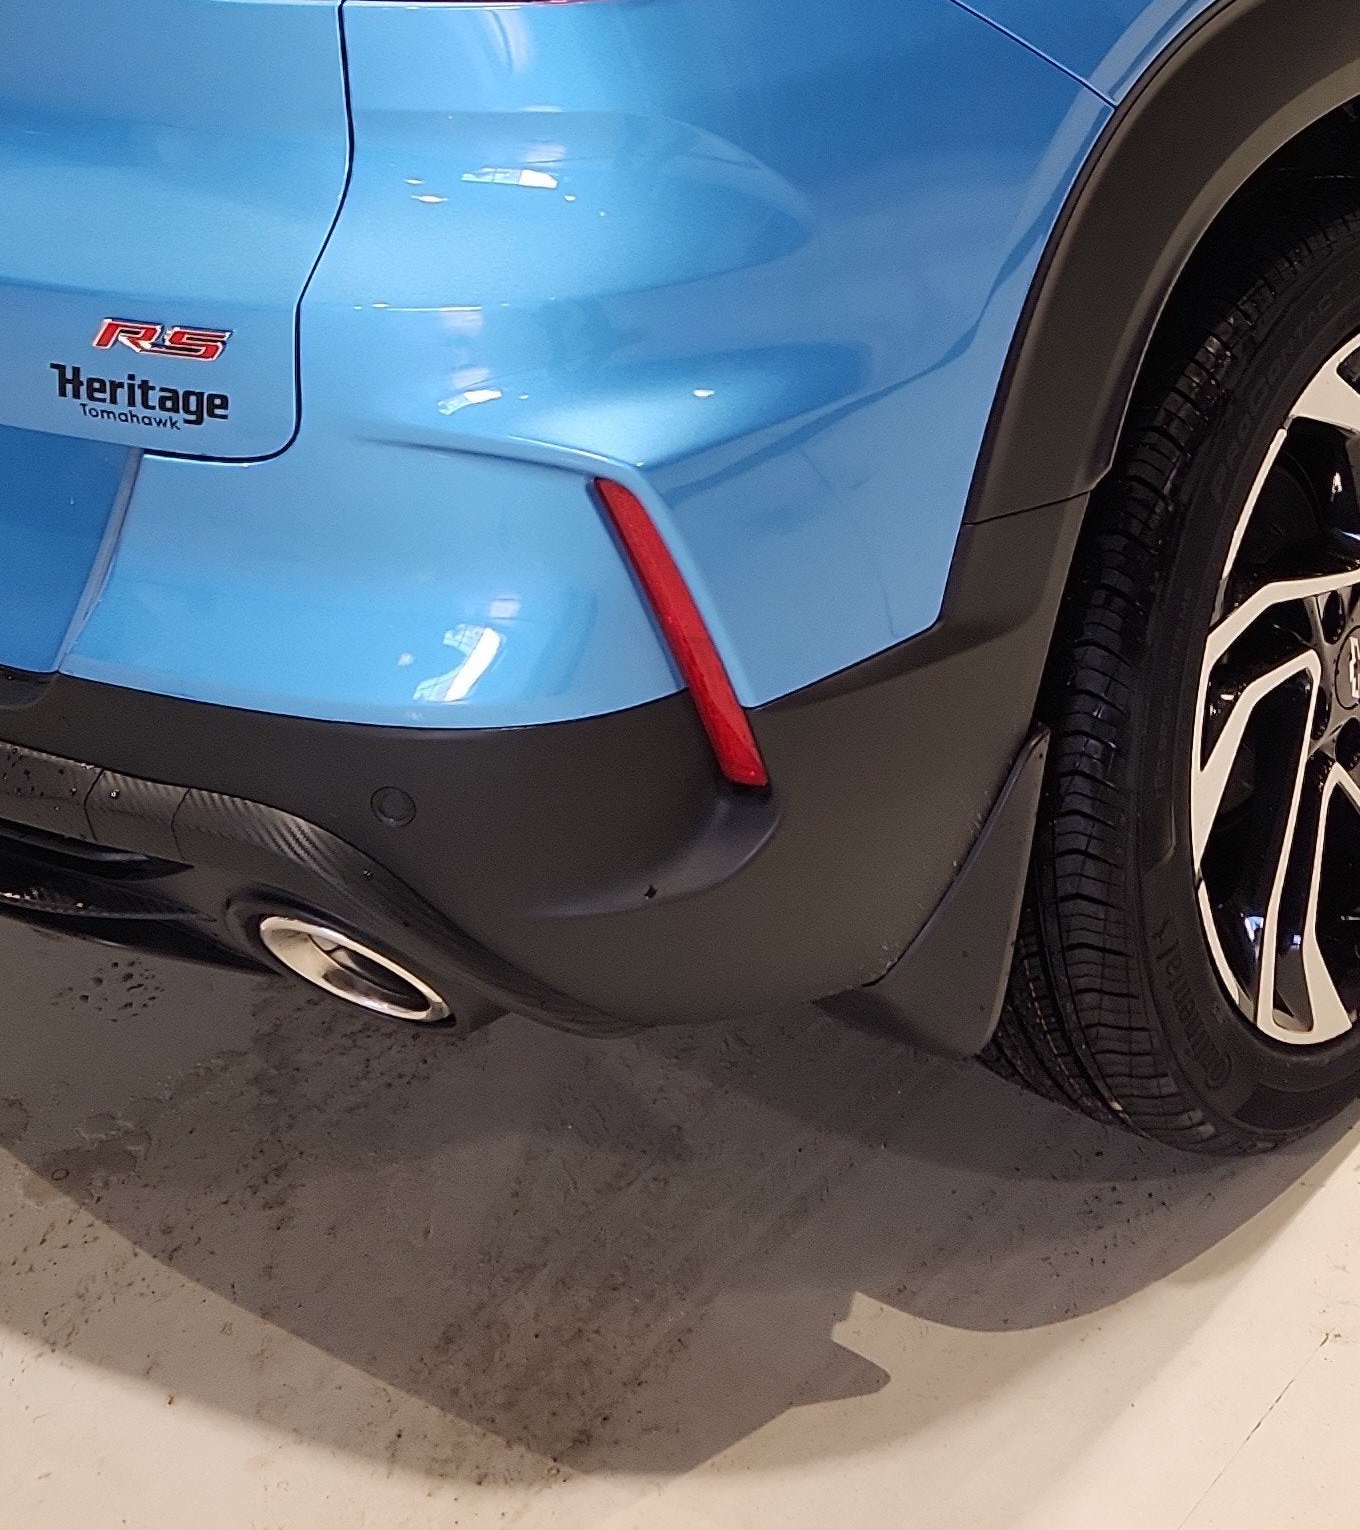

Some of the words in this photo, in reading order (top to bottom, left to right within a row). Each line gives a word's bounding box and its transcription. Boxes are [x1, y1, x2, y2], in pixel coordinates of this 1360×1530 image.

[93, 317, 234, 361] RS
[49, 362, 230, 426] Heritage
[80, 403, 181, 431] Tomahawk
